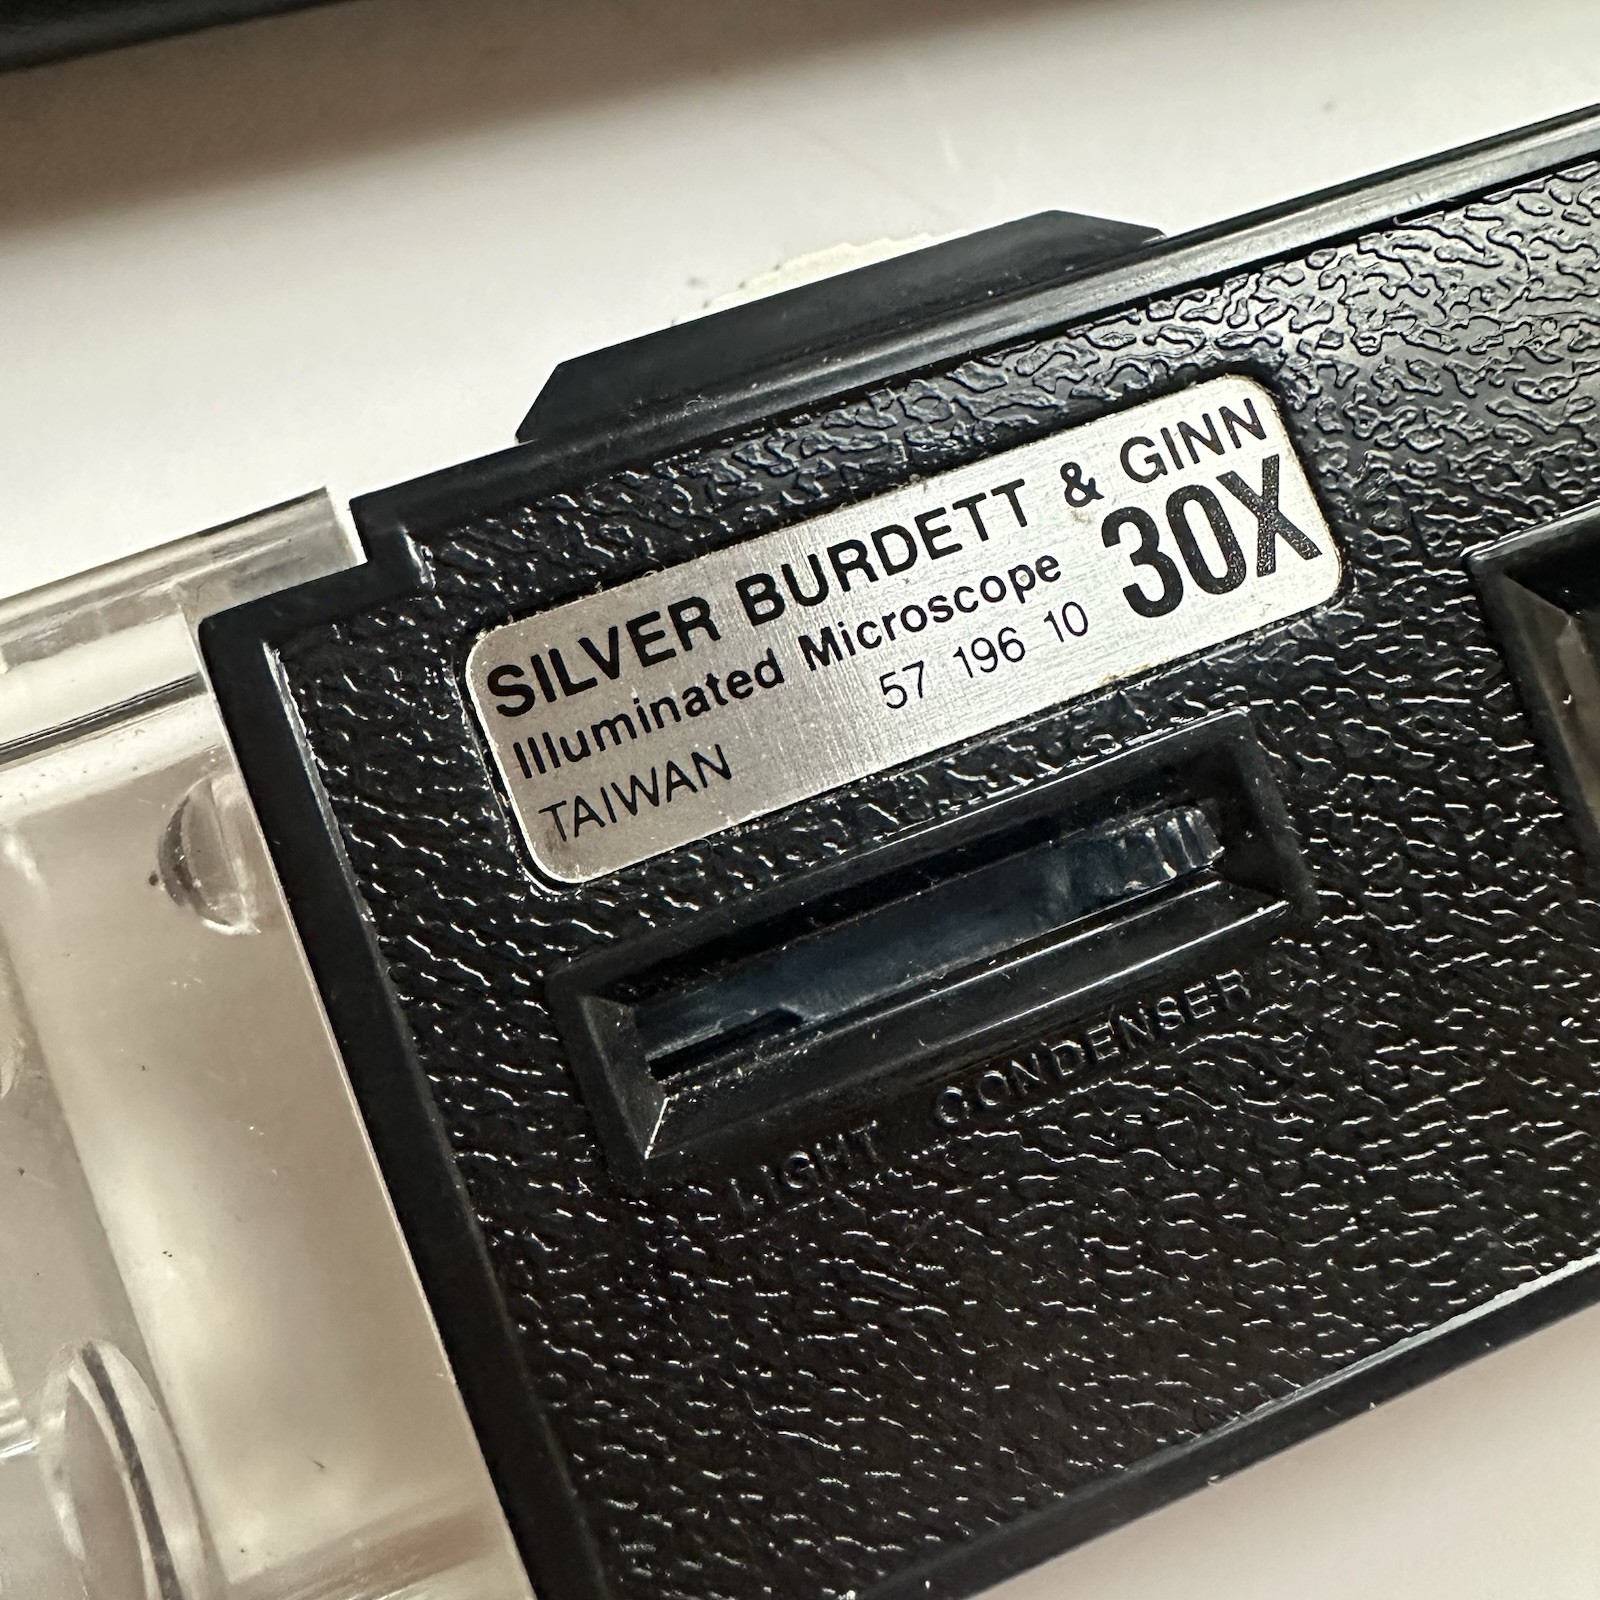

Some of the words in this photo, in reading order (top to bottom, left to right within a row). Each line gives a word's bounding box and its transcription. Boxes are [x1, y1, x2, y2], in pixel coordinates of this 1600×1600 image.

[487, 596, 720, 718] SILVER
[736, 479, 1028, 627] BURDETT
[1060, 461, 1105, 508] &
[1119, 398, 1267, 484] GINN
[1100, 454, 1323, 618] 30X
[513, 648, 784, 780] Illuminated
[798, 554, 1062, 671] Microscope
[880, 661, 927, 709] 57
[953, 627, 1026, 679] 196
[1044, 601, 1089, 643] 10
[538, 744, 732, 842] TAIWAN
[728, 1120, 884, 1213] LIGHT
[934, 968, 1251, 1125] CONDENSER
